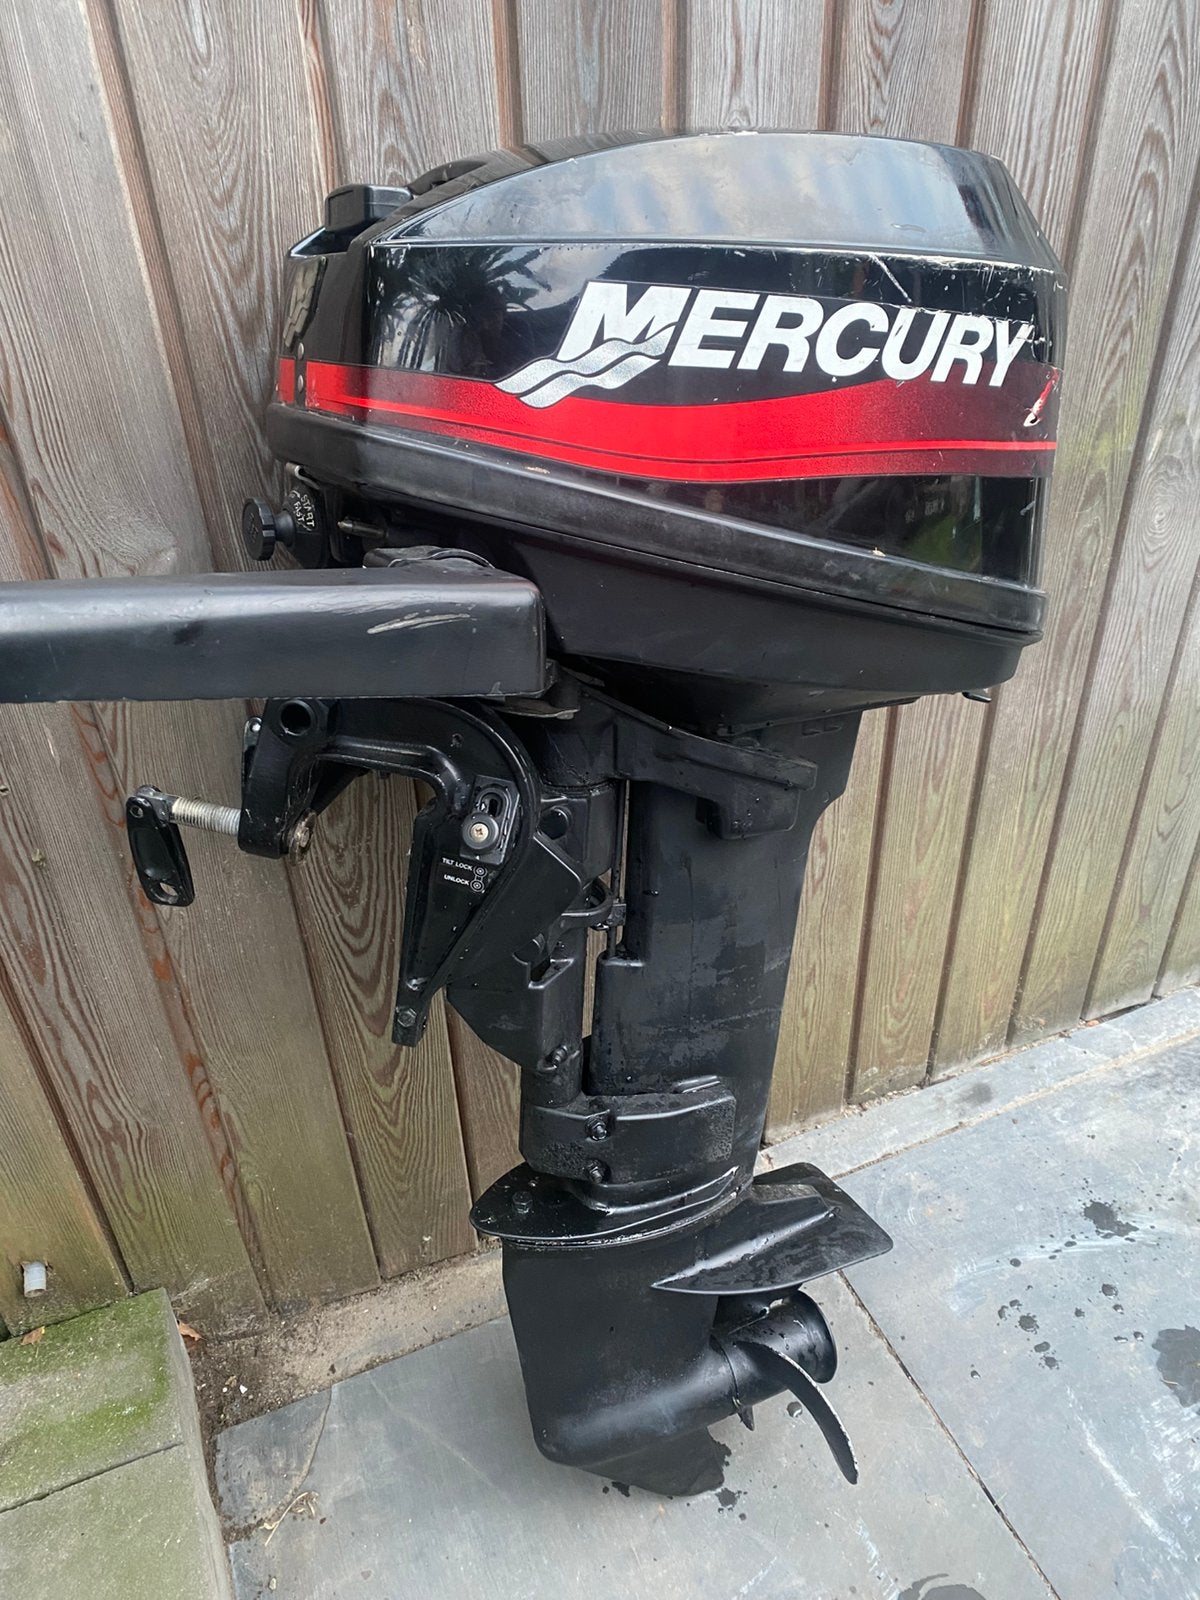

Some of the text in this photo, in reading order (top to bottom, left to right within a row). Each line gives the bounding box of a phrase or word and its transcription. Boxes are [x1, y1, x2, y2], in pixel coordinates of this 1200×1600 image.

[557, 280, 1033, 388] MERCURY
[294, 501, 305, 521] FAST
[301, 494, 315, 526] START
[442, 857, 473, 871] TILT LOCK
[443, 874, 470, 885] UNLOCK
